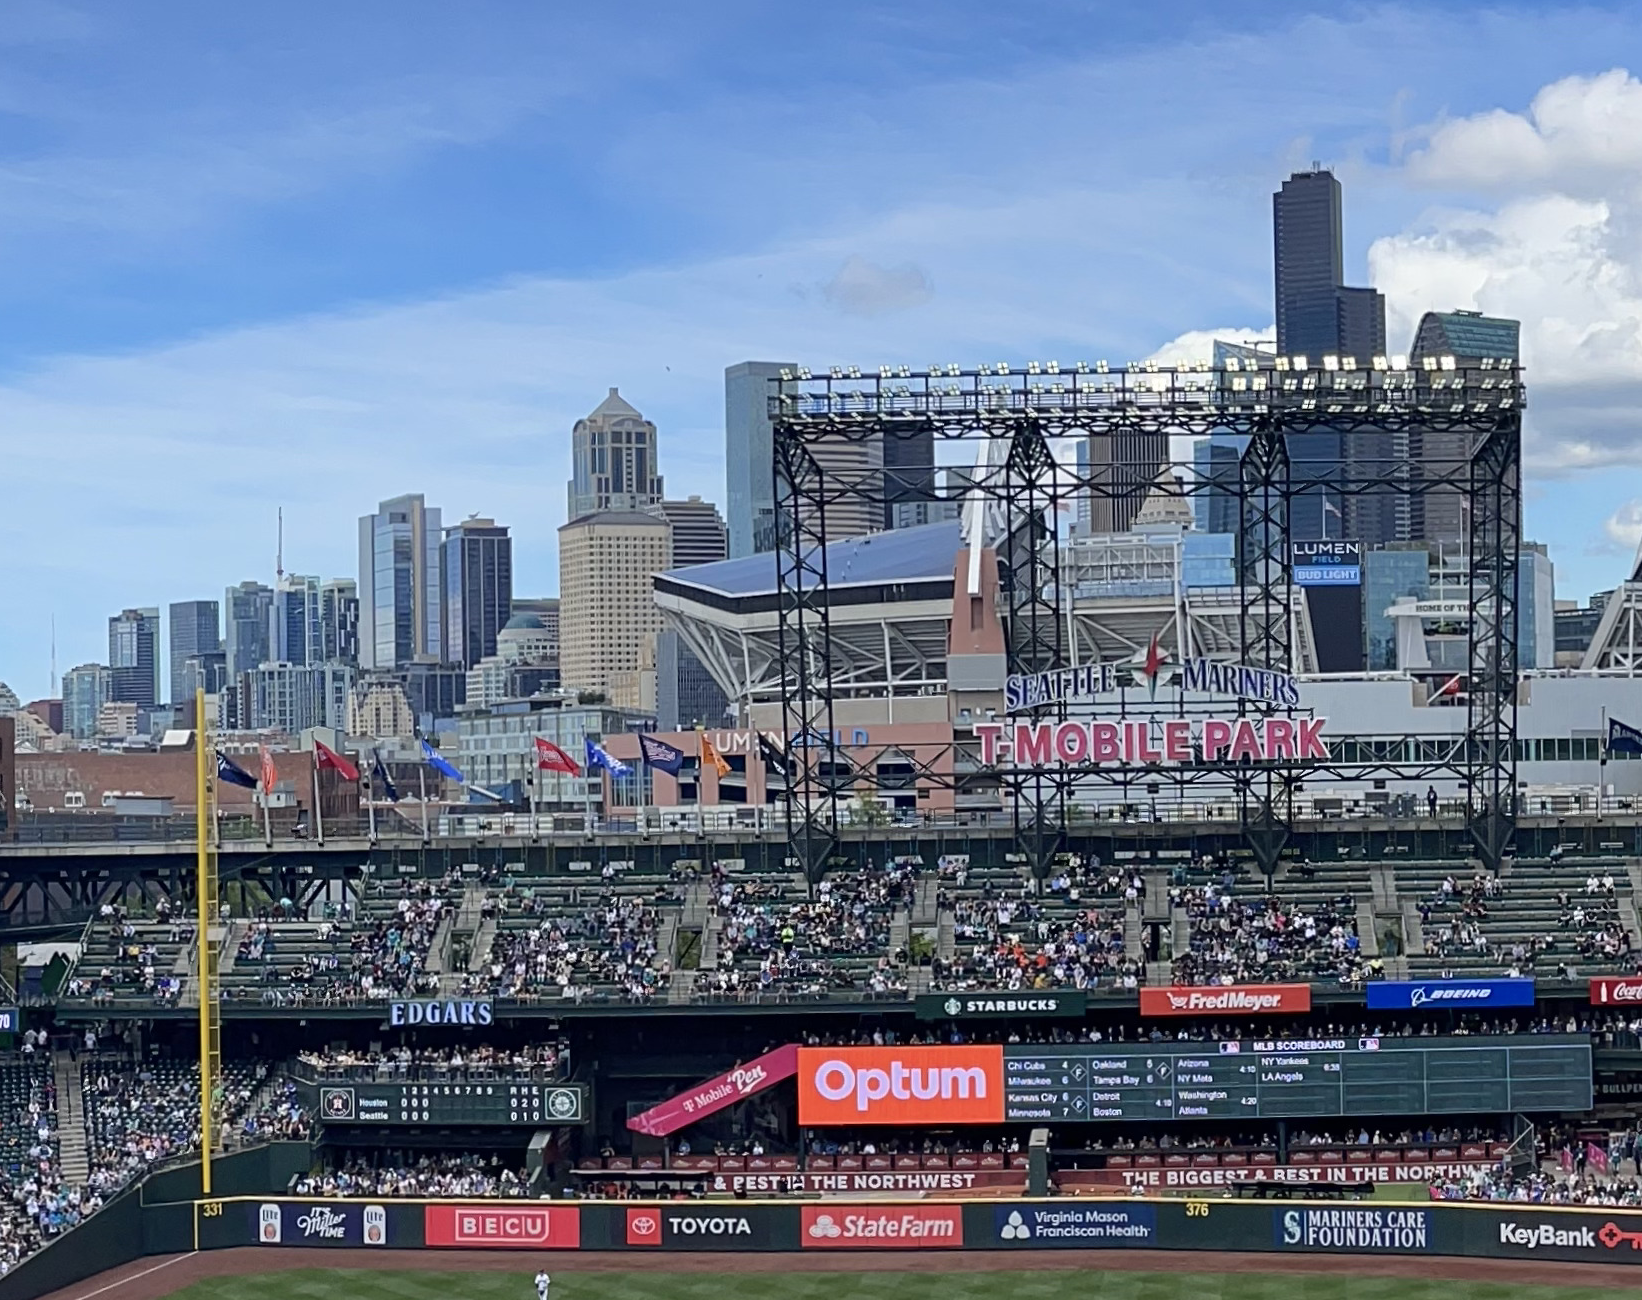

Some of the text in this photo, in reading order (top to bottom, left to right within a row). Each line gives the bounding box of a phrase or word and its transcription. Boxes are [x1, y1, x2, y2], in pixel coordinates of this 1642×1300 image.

[1294, 543, 1359, 554] LUMEN
[1298, 570, 1356, 579] BUD LIGHT
[1006, 658, 1300, 712] SEATTLE MARINERS
[973, 718, 1330, 766] T-MOBILE PARK
[1431, 988, 1490, 998] BOEING
[967, 999, 1056, 1012] STARBUCKS
[392, 1002, 492, 1025] EDGAR'S
[1253, 1041, 1345, 1050] MLB SCOREBOARD
[815, 1060, 986, 1111] Optum
[811, 1175, 848, 1189] THE
[854, 1174, 975, 1189] NORTHWEST
[1123, 1172, 1159, 1186] THE
[1167, 1170, 1248, 1185] BIGGEST
[1327, 1167, 1351, 1181] IN
[1352, 1167, 1389, 1181] THE
[203, 1203, 223, 1217] 331
[1186, 1203, 1209, 1217] 376
[298, 1213, 346, 1236] Miller
[1035, 1211, 1128, 1225] Virginia Mason
[1308, 1211, 1426, 1227] MARINERS CARE
[320, 1226, 345, 1238] TIME
[669, 1218, 751, 1235] TOYOTA
[1035, 1224, 1148, 1238] Franciscan Health
[1308, 1229, 1427, 1248] FOUNDATION
[1500, 1223, 1595, 1251] KeyBank
